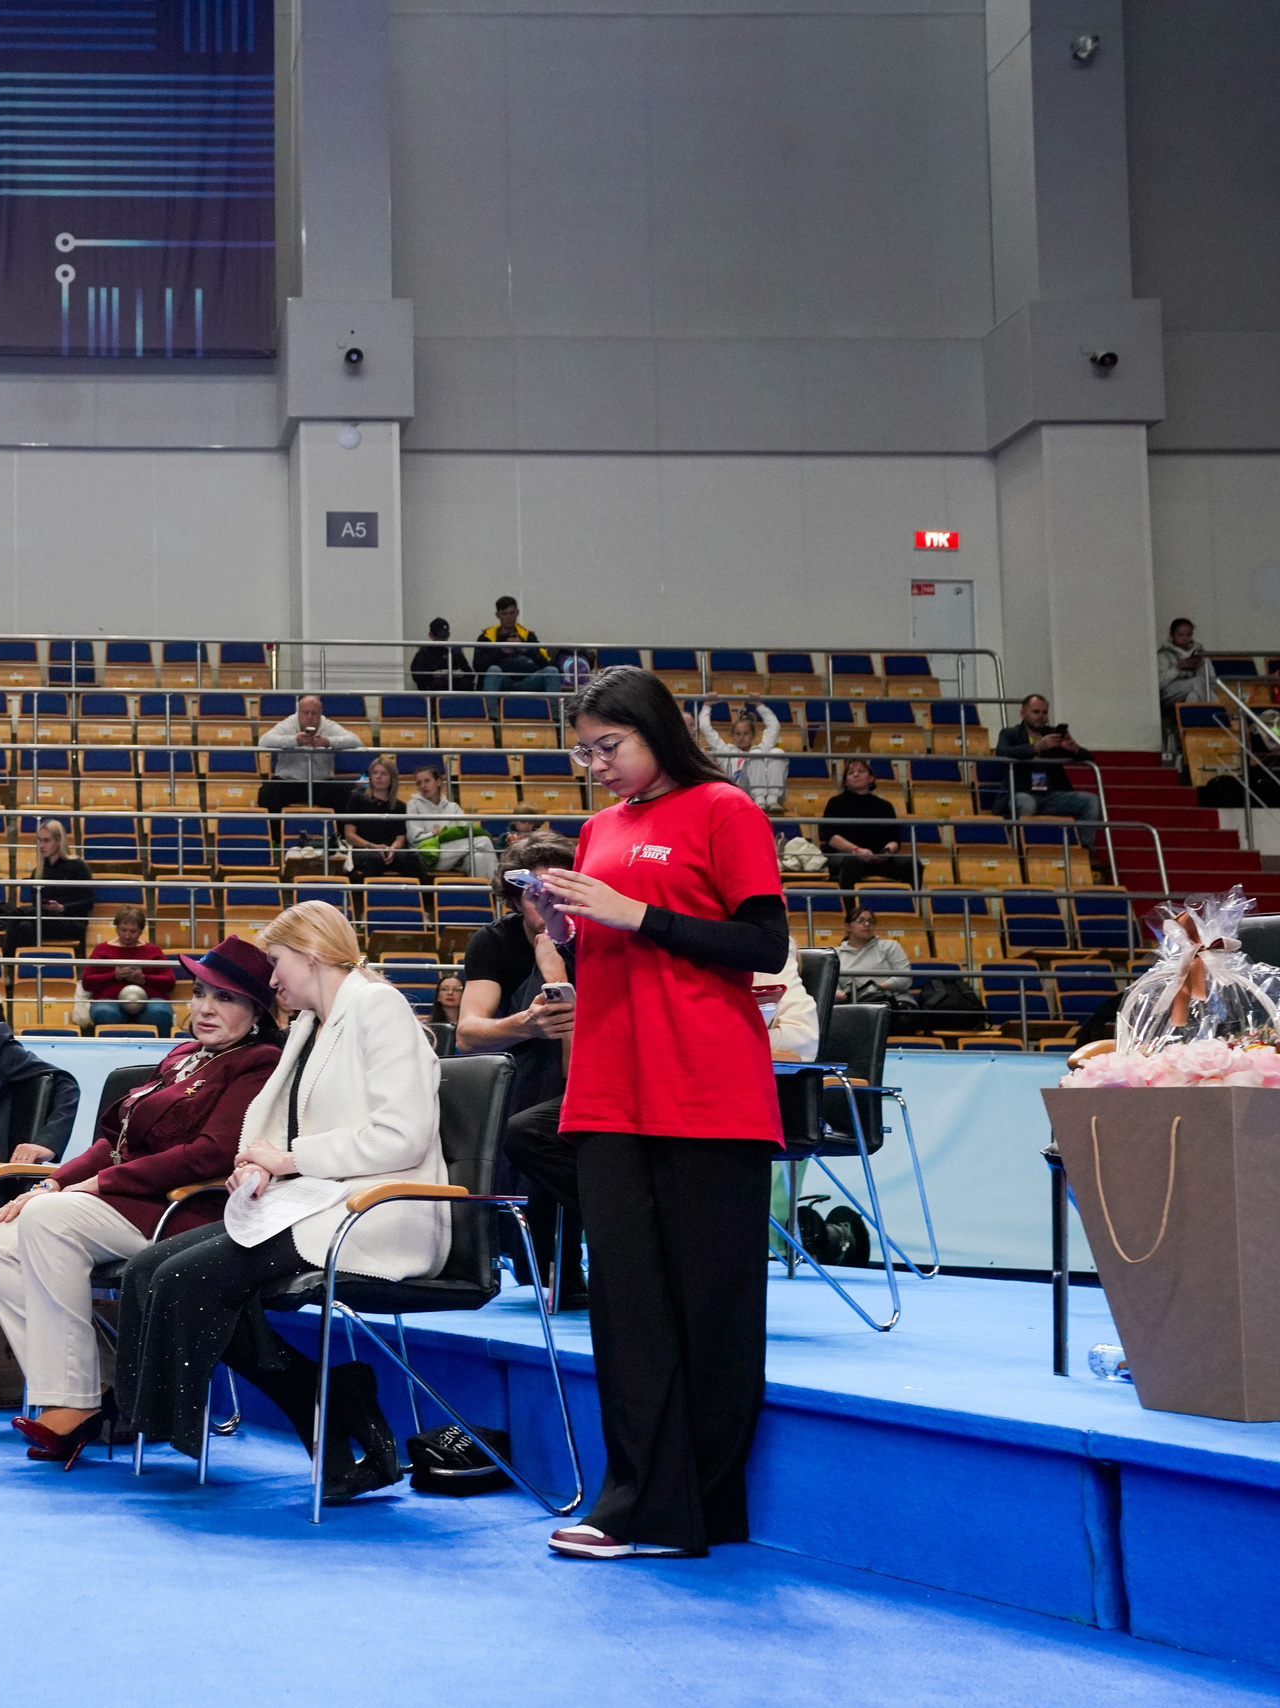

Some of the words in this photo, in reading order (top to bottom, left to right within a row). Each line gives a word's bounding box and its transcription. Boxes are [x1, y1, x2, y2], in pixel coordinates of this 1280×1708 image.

[341, 521, 367, 538] A5
[925, 532, 950, 547] ПК
[639, 851, 667, 861] ЛИГА
